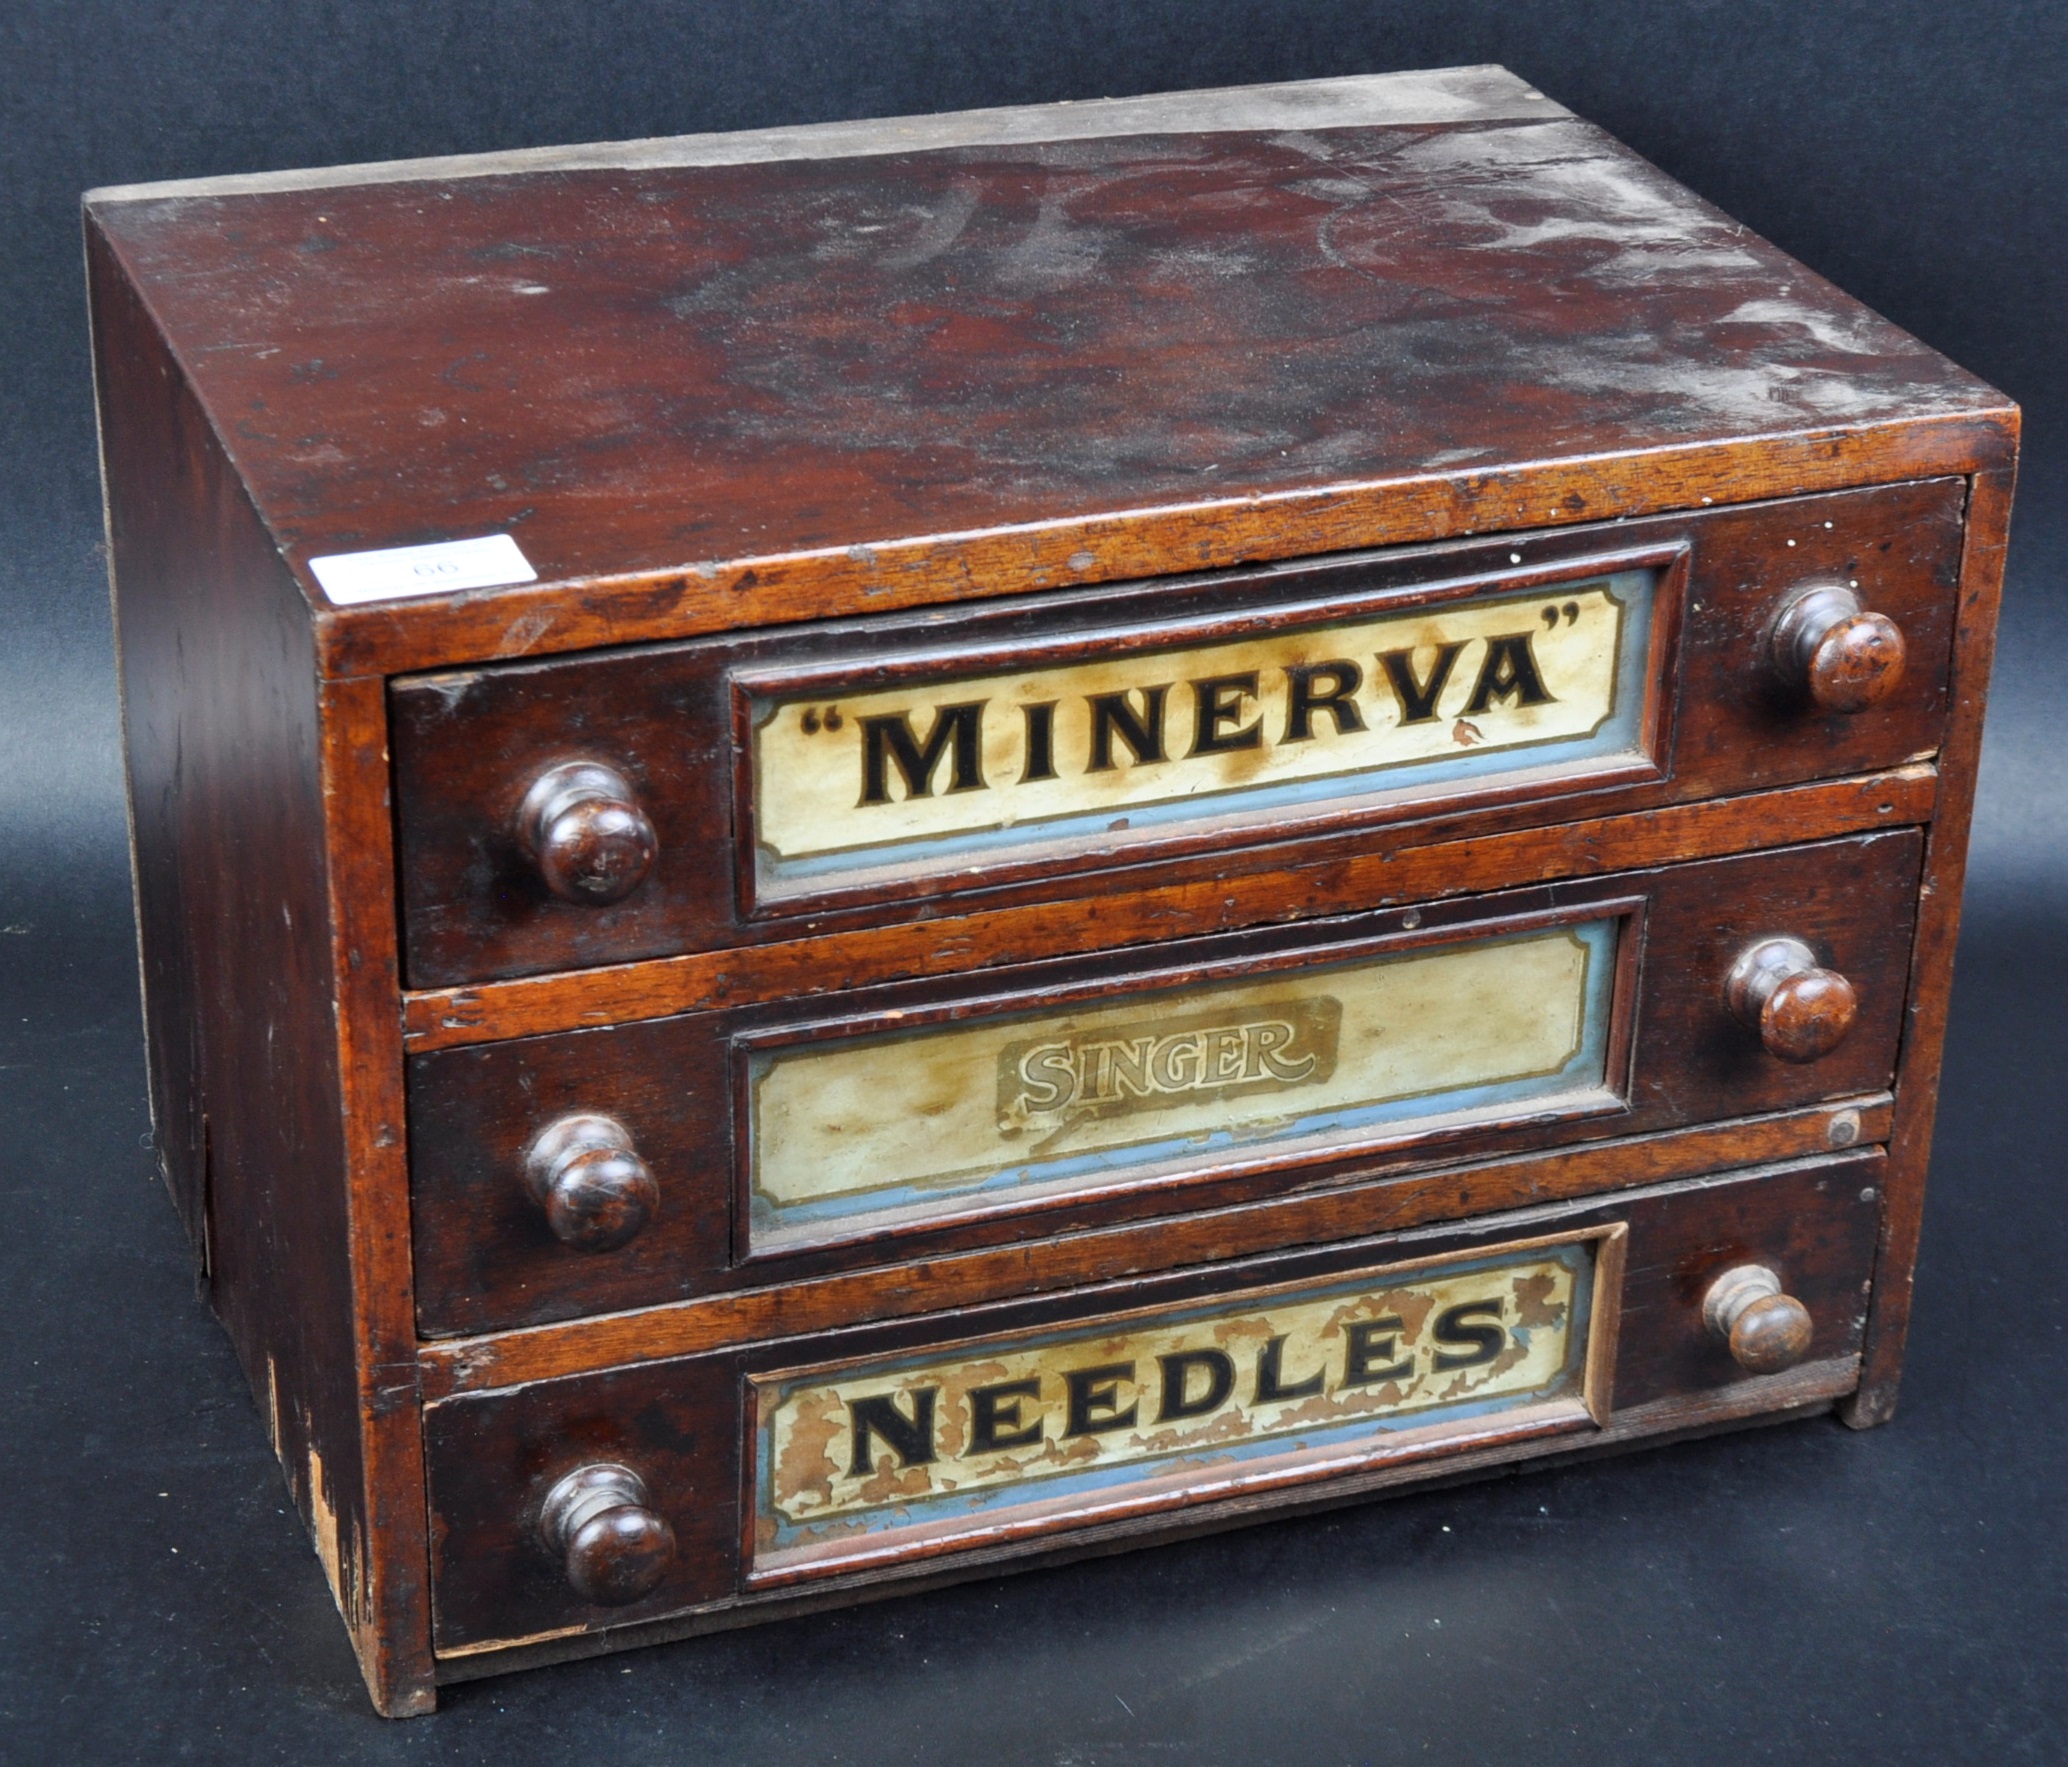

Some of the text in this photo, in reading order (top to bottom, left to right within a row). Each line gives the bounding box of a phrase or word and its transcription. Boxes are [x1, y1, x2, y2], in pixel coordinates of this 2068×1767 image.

[413, 560, 459, 577] 66
[1020, 1022, 1315, 1114] SINGER
[845, 1296, 1511, 1480] NEEDLES
